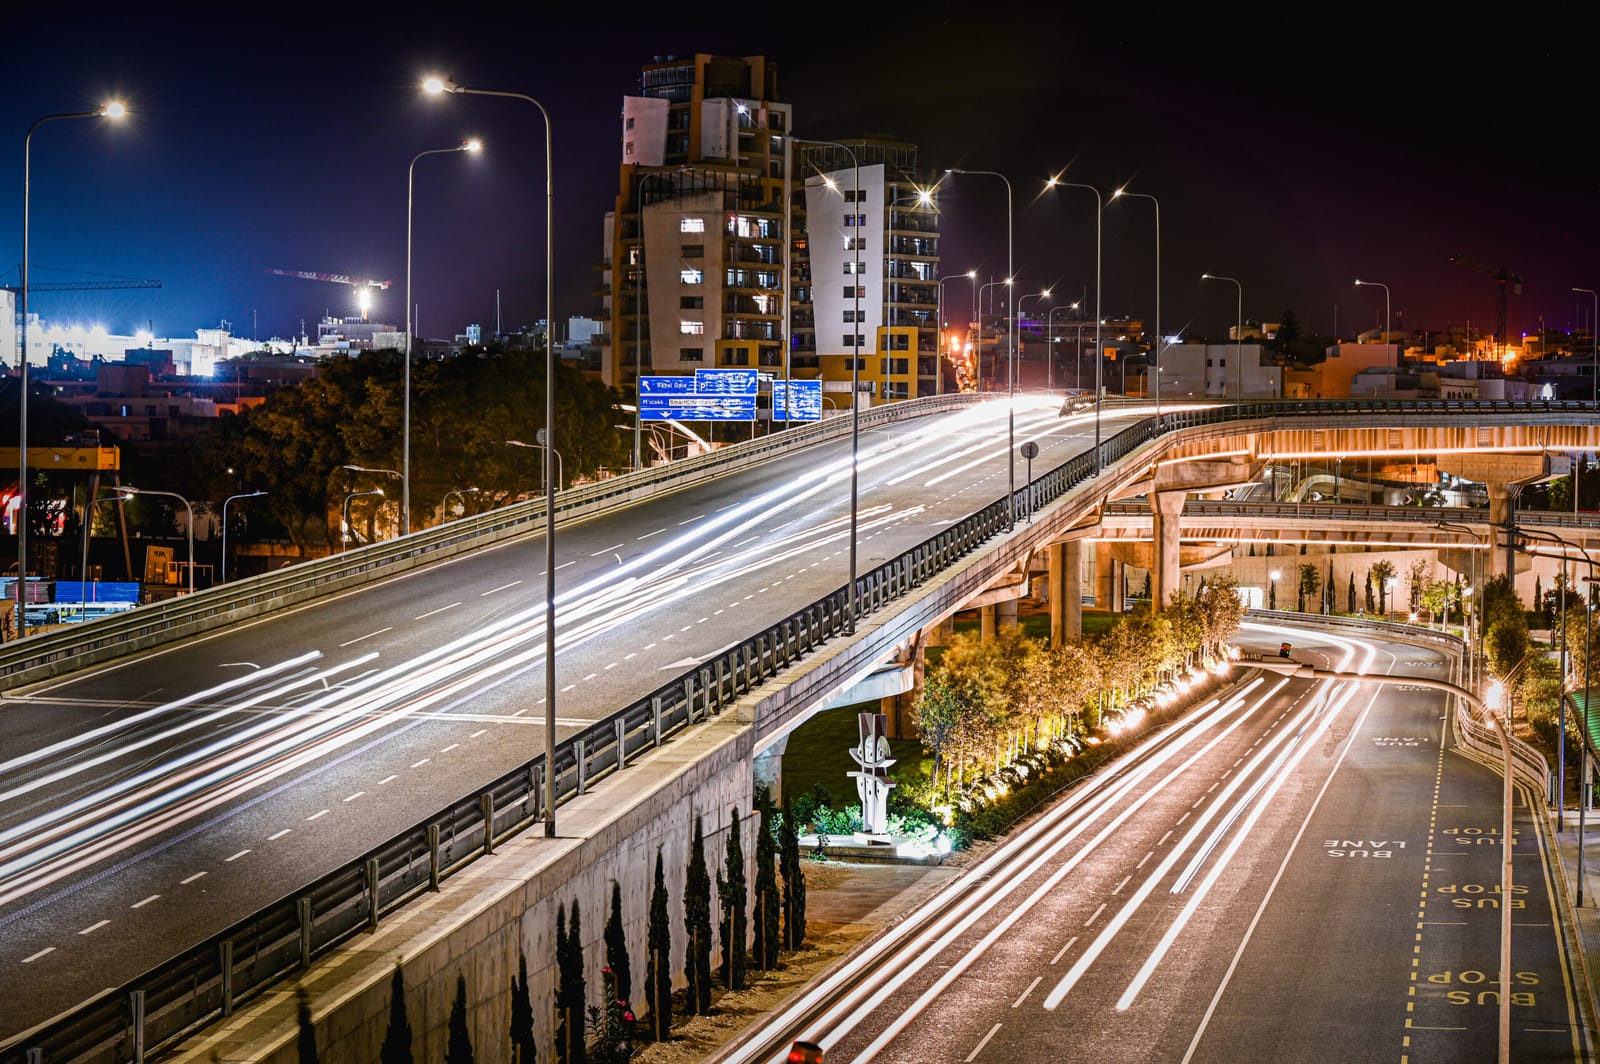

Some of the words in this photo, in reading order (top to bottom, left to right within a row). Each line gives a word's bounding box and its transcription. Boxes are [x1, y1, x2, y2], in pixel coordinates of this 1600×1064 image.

[1442, 827, 1520, 835] STOP
[1323, 839, 1406, 848] LANE
[1327, 849, 1393, 858] BUS
[1437, 884, 1529, 894] STOP
[1451, 898, 1527, 909] BUS
[1427, 970, 1540, 985] STOP
[1446, 990, 1536, 1007] BUS
